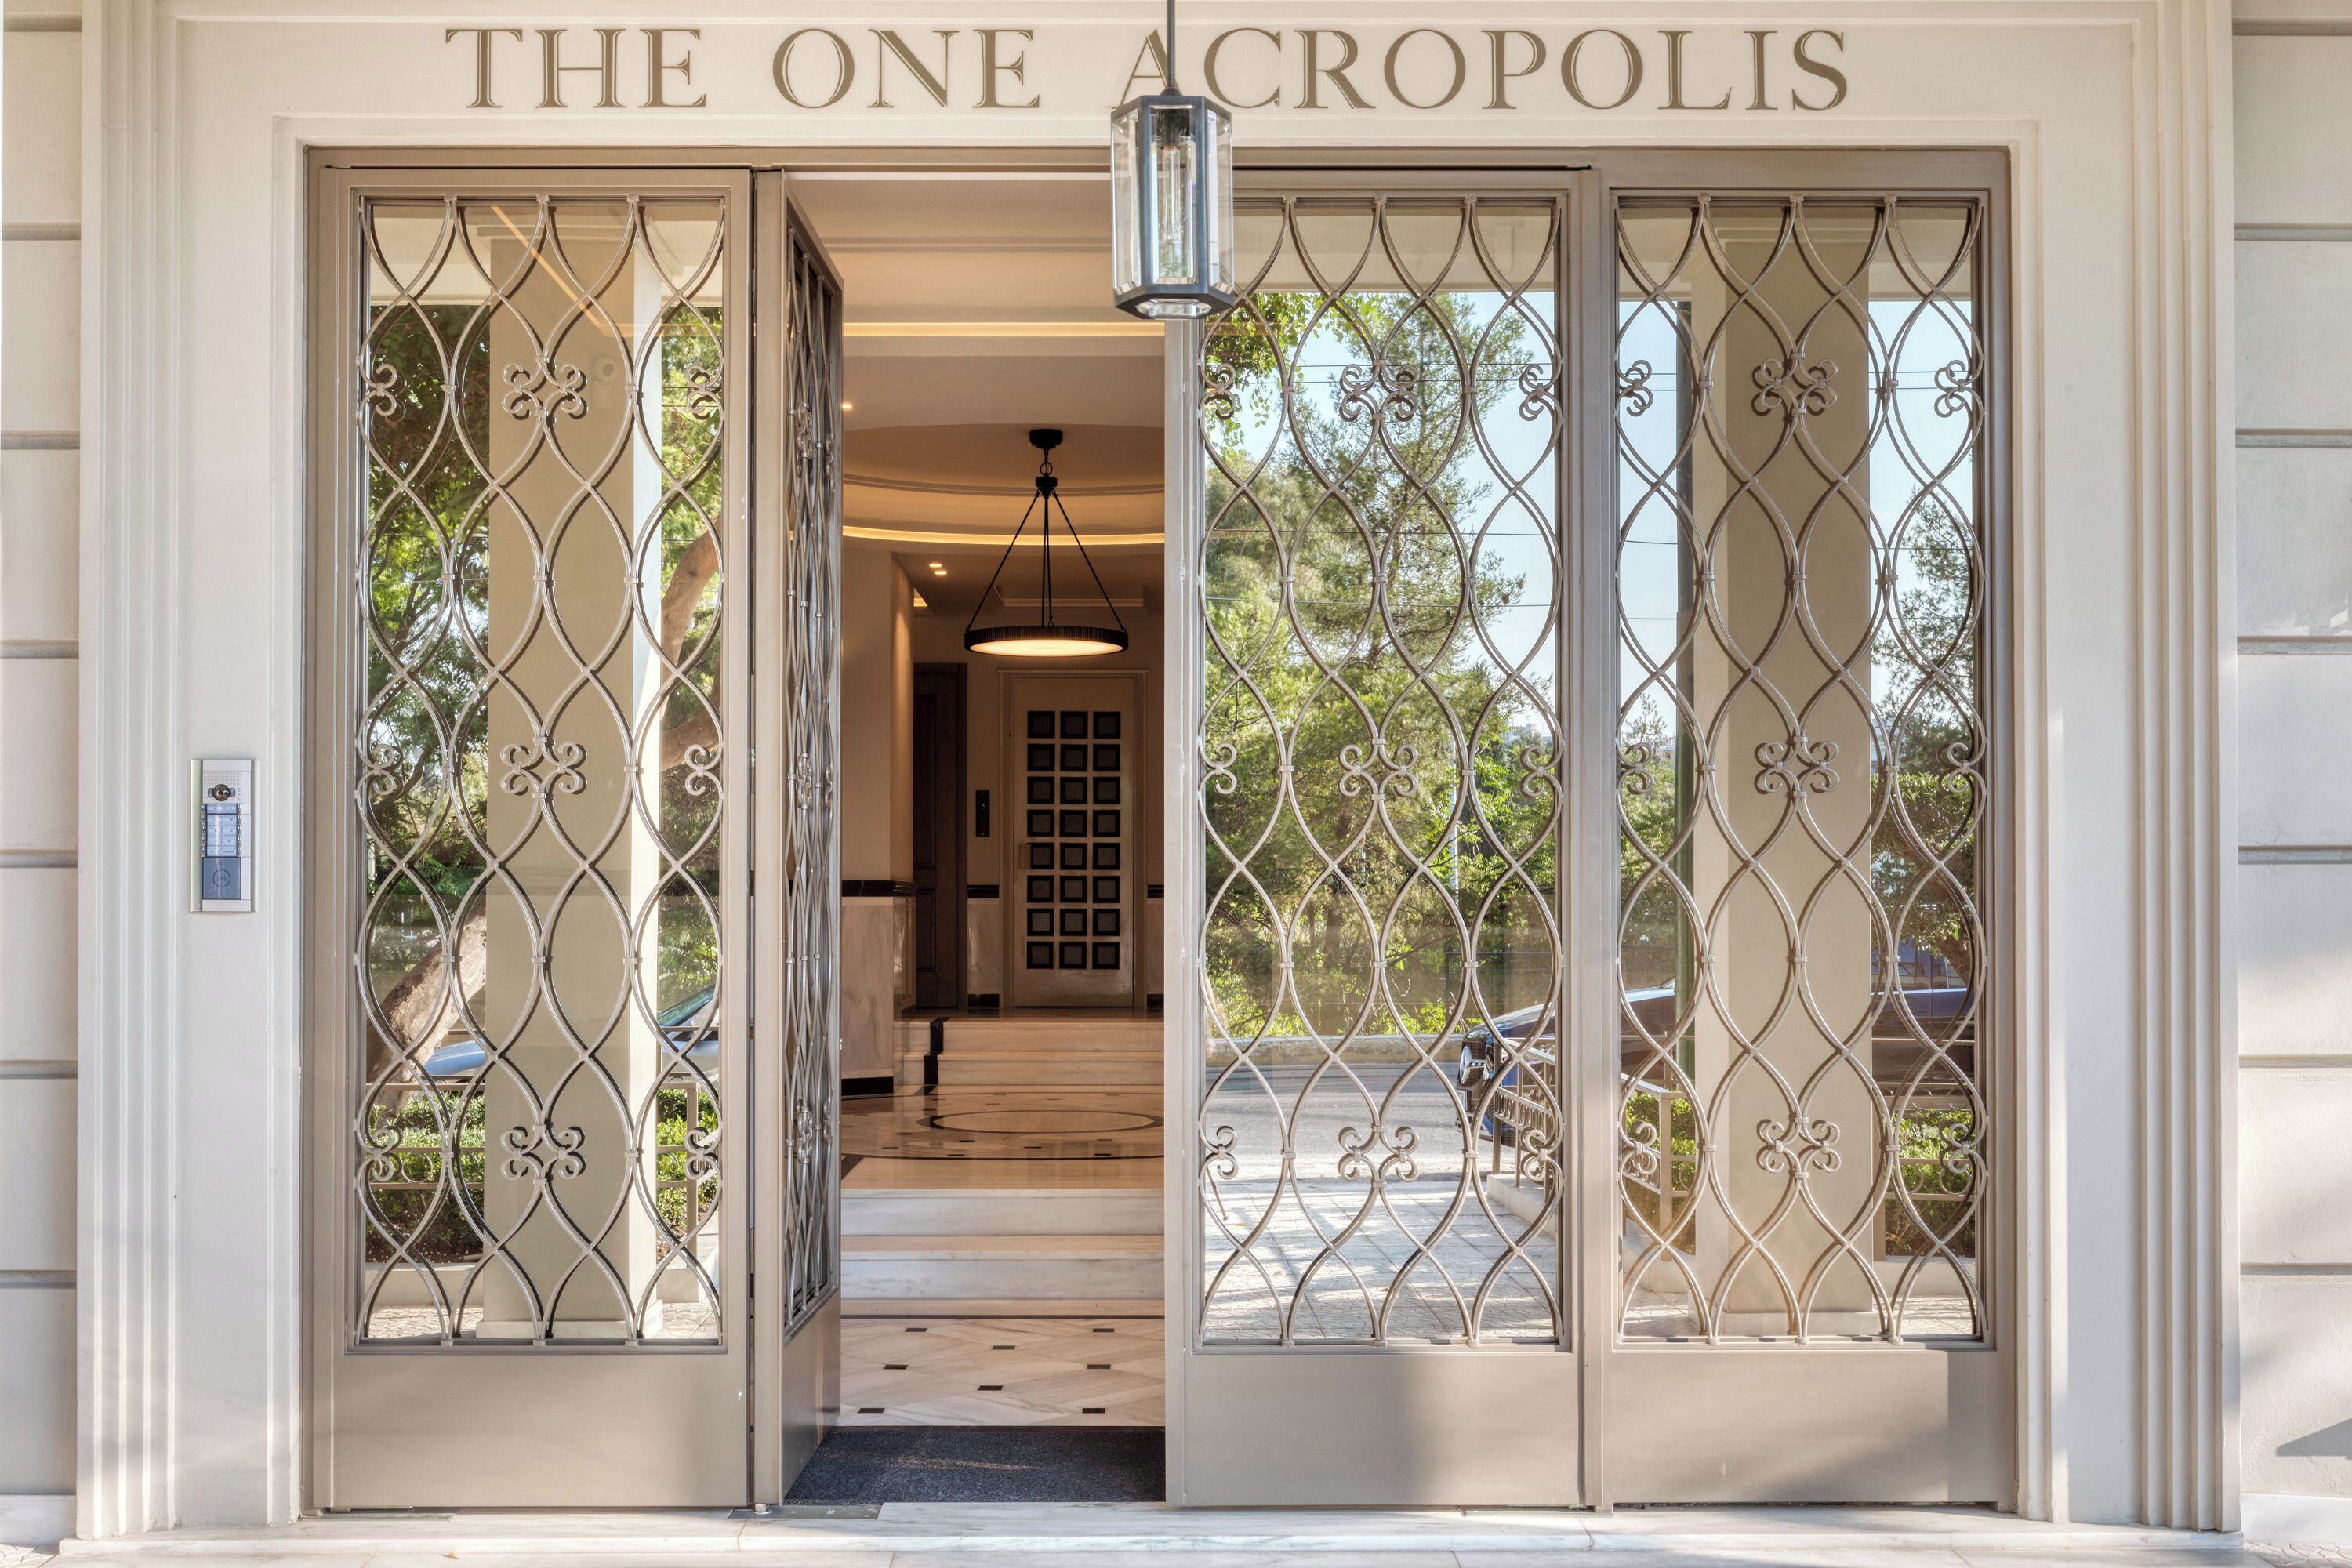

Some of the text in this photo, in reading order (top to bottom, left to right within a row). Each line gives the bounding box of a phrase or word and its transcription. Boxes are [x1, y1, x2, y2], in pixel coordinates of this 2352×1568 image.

[445, 27, 1848, 111] THE ONE ACROPOLIS
